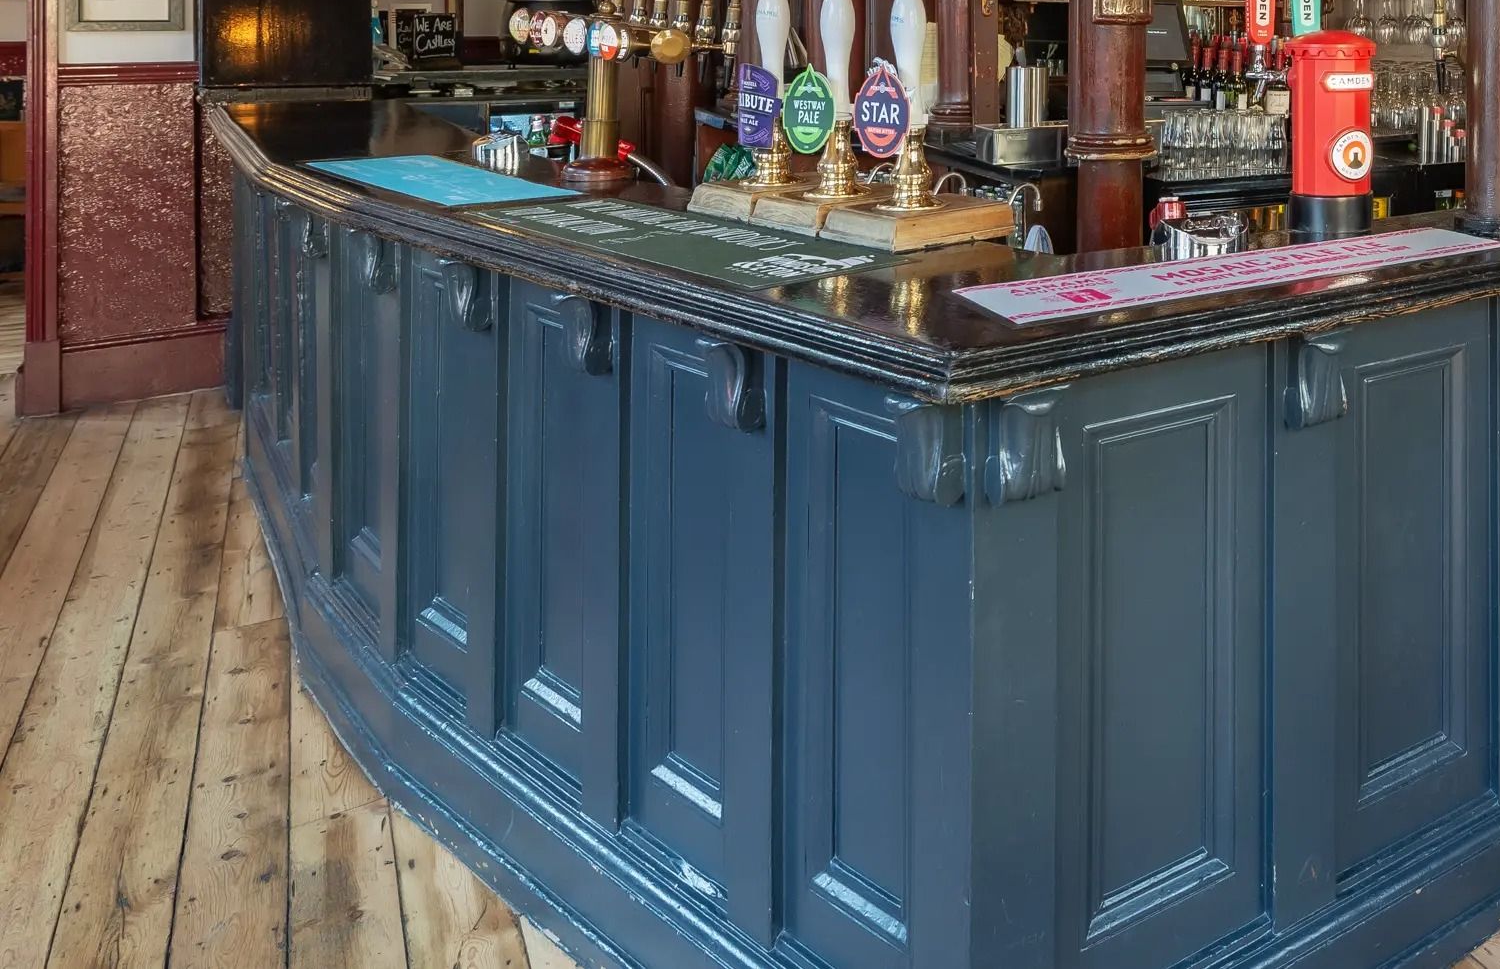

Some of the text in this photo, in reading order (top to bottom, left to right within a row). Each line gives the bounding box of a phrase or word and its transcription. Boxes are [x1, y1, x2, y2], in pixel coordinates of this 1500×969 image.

[415, 17, 430, 33] WE
[432, 17, 452, 33] ARE
[738, 92, 775, 114] RIBUTE
[793, 99, 826, 111] WESTWAY
[861, 100, 900, 125] STAR
[797, 110, 820, 125] PALE
[1151, 241, 1390, 282] MOSAIC PALE ALE
